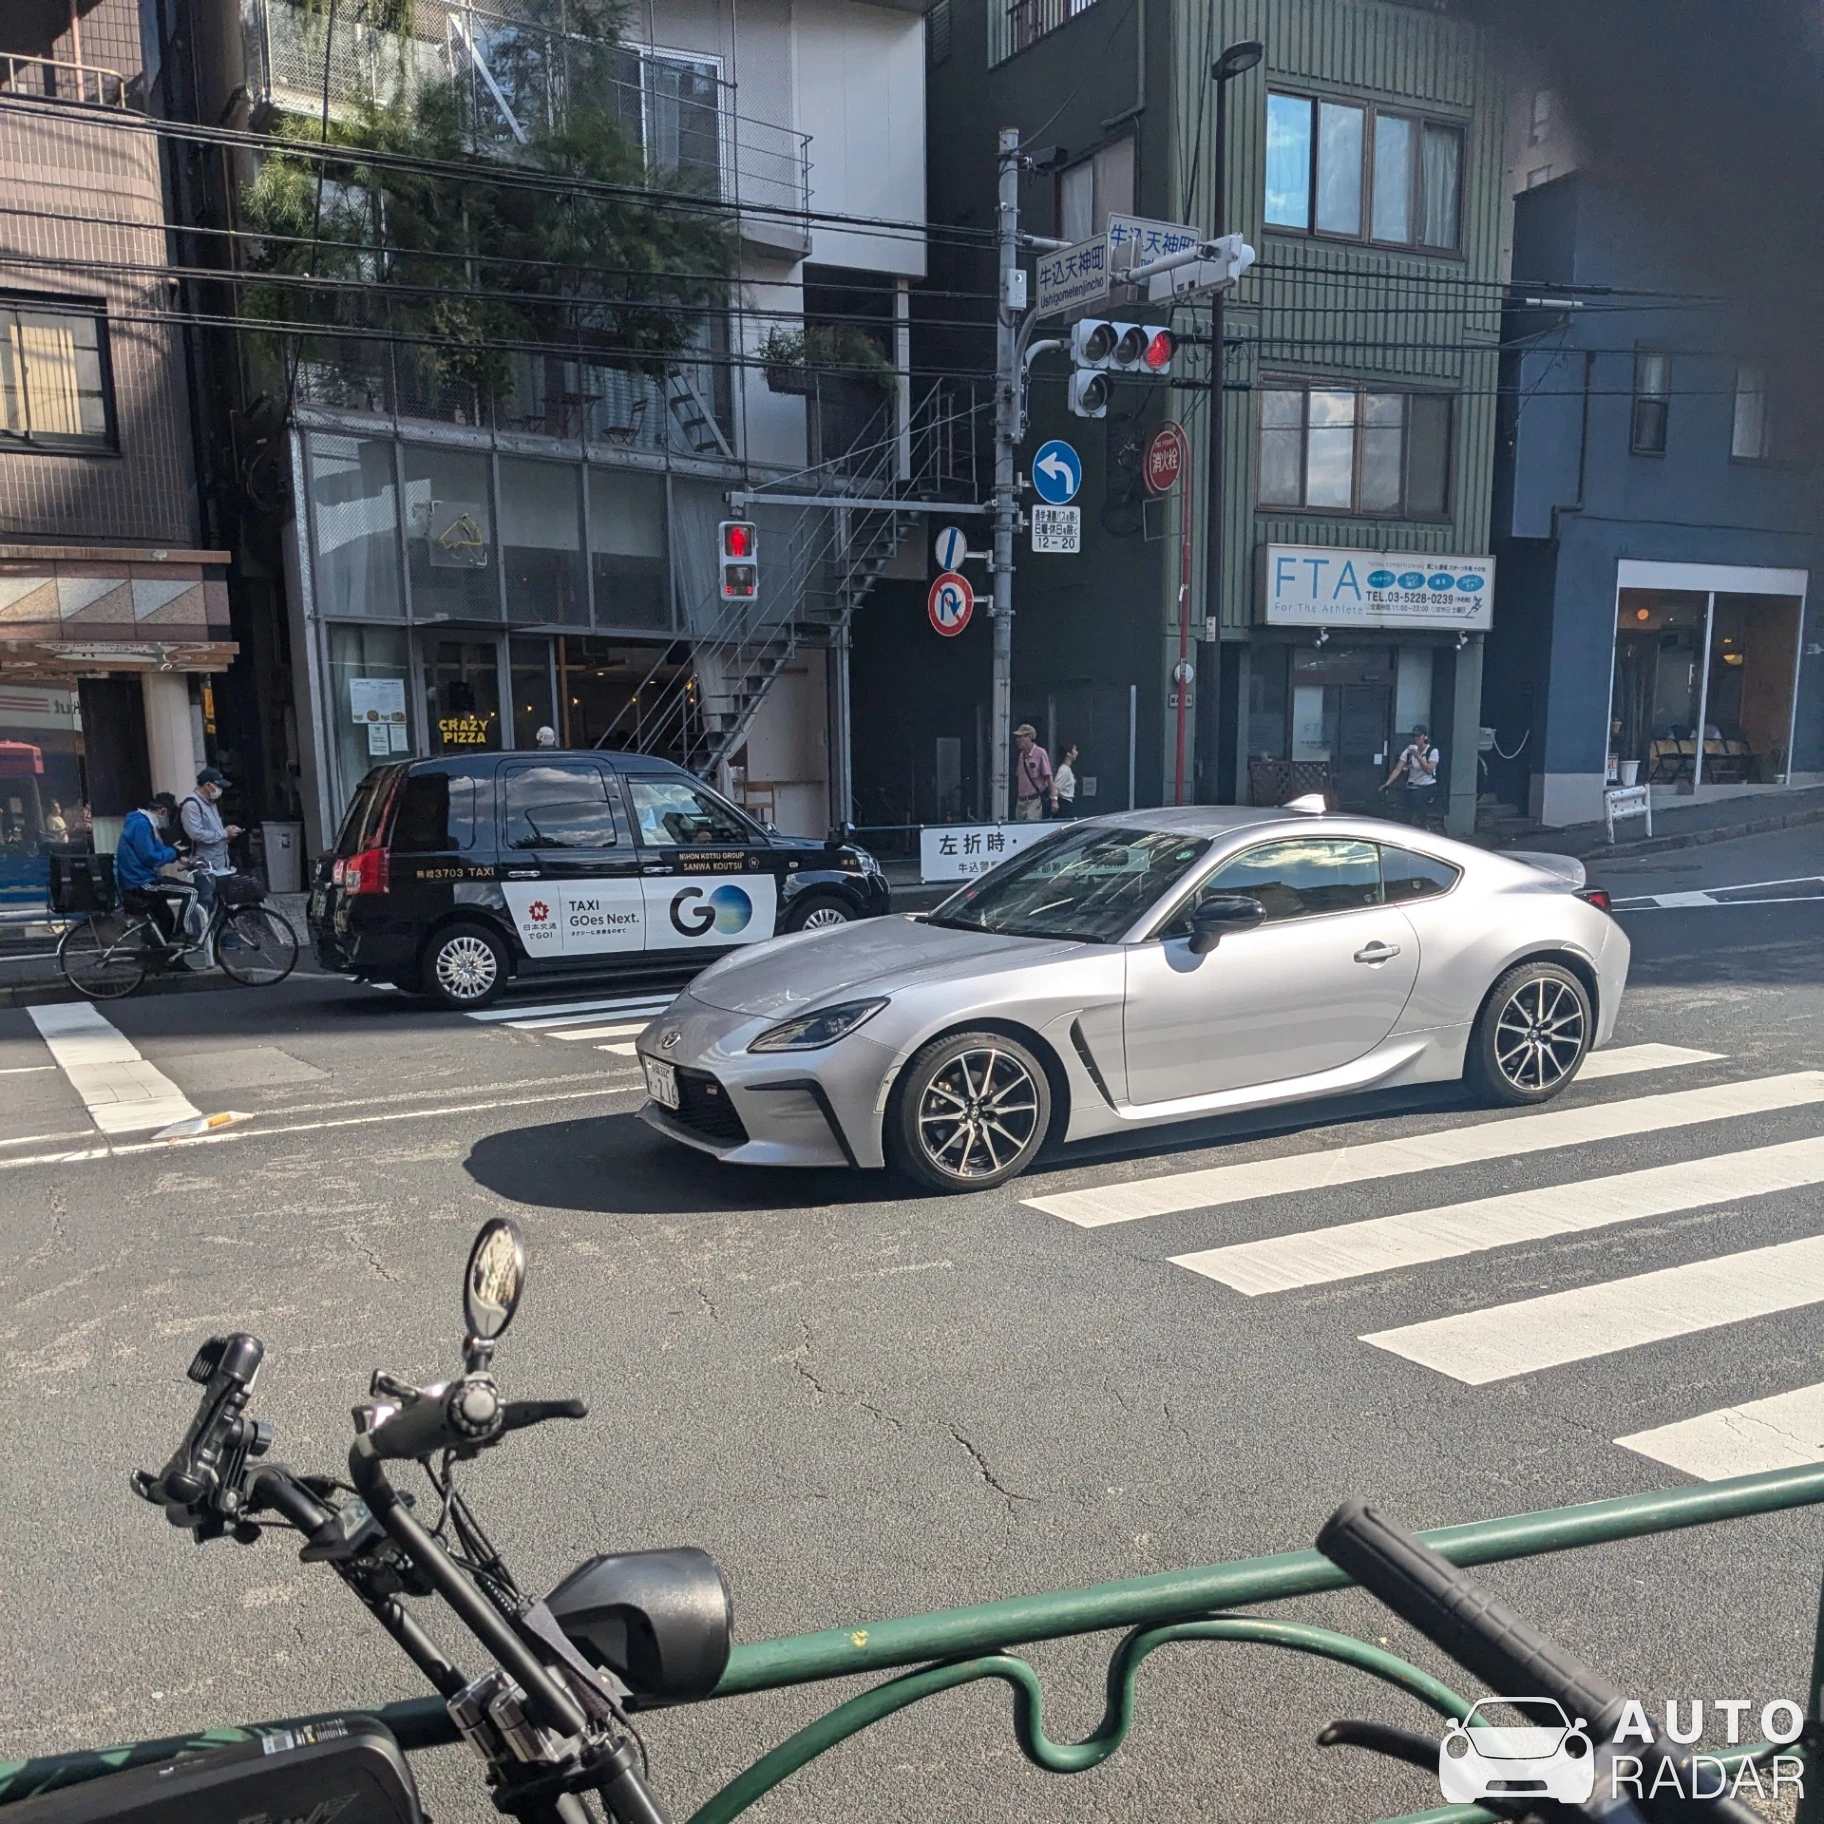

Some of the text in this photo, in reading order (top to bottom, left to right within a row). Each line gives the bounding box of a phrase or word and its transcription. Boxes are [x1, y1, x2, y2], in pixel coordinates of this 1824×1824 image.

[1040, 244, 1105, 291] 牛込天神町
[1153, 447, 1178, 474] 消火栓
[1276, 557, 1361, 601] FTA
[1275, 602, 1364, 615] For The Athlete
[439, 719, 489, 731] CRAZY
[443, 732, 487, 743] PIZZA
[700, 852, 721, 860] KOTSU
[683, 861, 743, 871] SANWA KOUTSU
[467, 867, 495, 877] TAXI
[568, 900, 600, 911] TAXI
[569, 912, 640, 926] GOes Next.
[523, 923, 557, 931] 日本交通
[529, 932, 553, 940] でGO!
